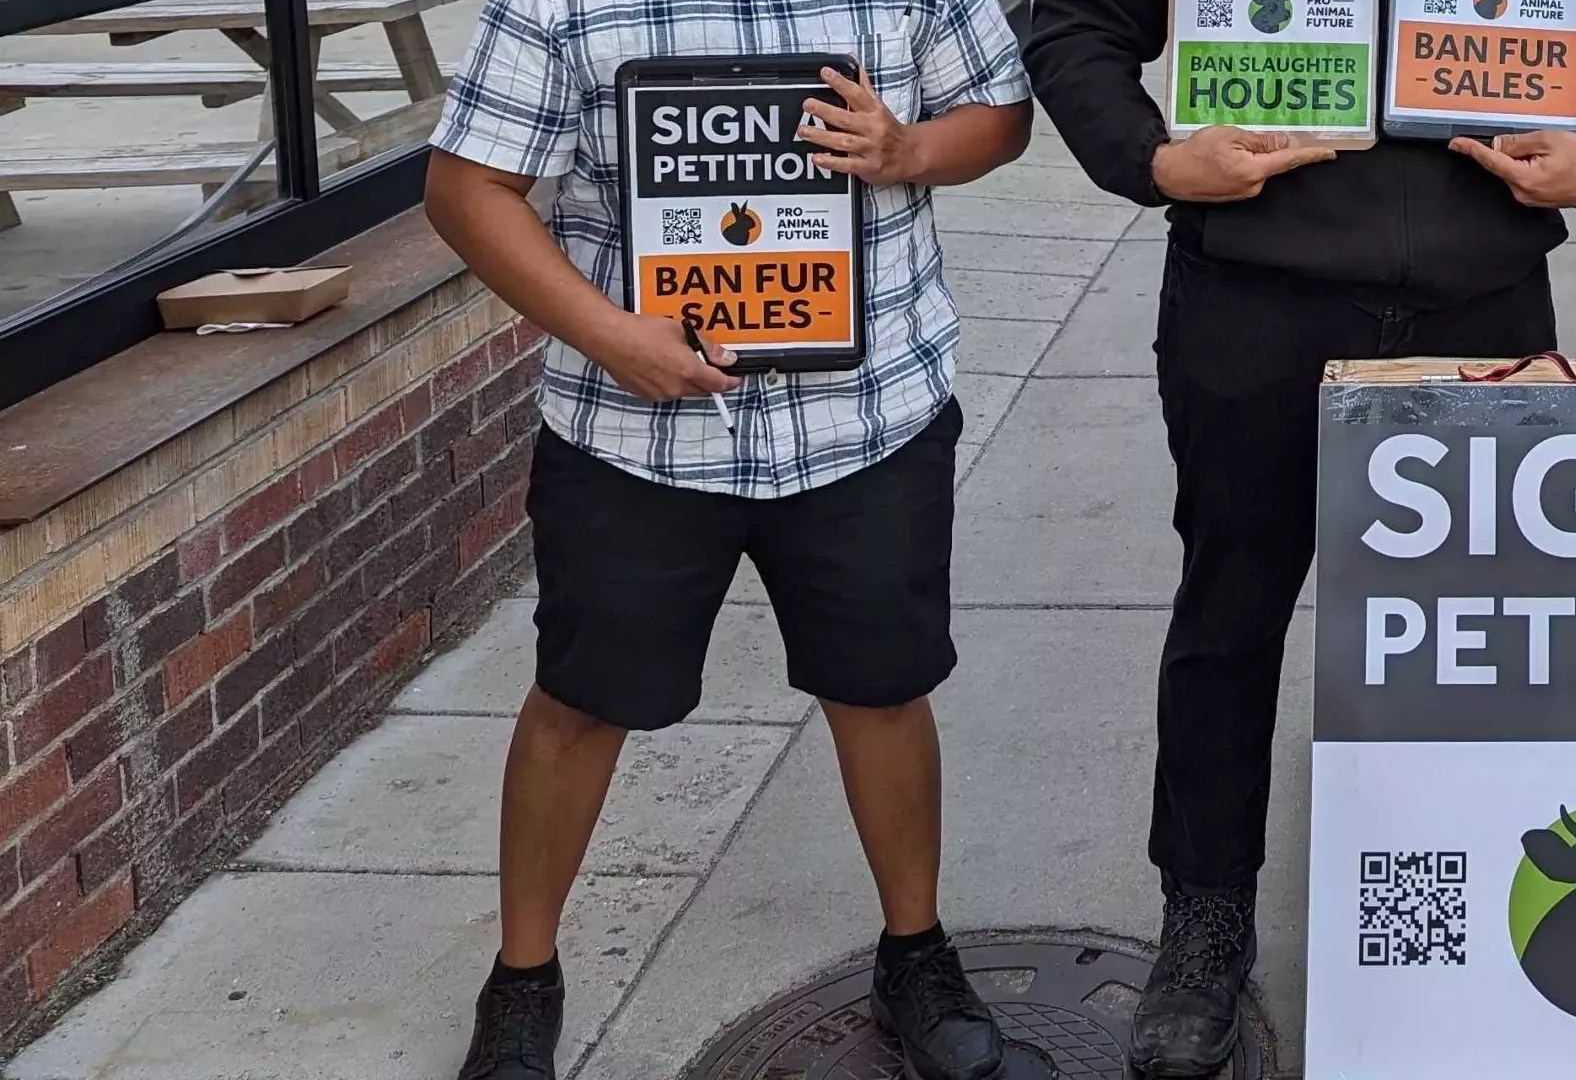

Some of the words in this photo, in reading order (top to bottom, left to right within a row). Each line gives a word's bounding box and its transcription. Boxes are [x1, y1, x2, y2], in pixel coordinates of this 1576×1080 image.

[1307, 7, 1354, 17] ANIMAL
[1519, 9, 1564, 20] FUTURE
[1306, 18, 1354, 28] FUTURE
[1415, 31, 1487, 63] BAN
[1499, 37, 1567, 68] FUR
[1191, 56, 1232, 72] BAN
[1240, 57, 1356, 73] SLAUGHTER
[1190, 77, 1356, 111] HOUSES
[651, 105, 779, 145] SIGN
[653, 153, 832, 183] PETITION
[777, 207, 803, 217] PRO
[777, 219, 829, 229] ANIMAL
[777, 230, 829, 240] FUTURE
[656, 264, 742, 296] BAN
[756, 262, 836, 293] FUR
